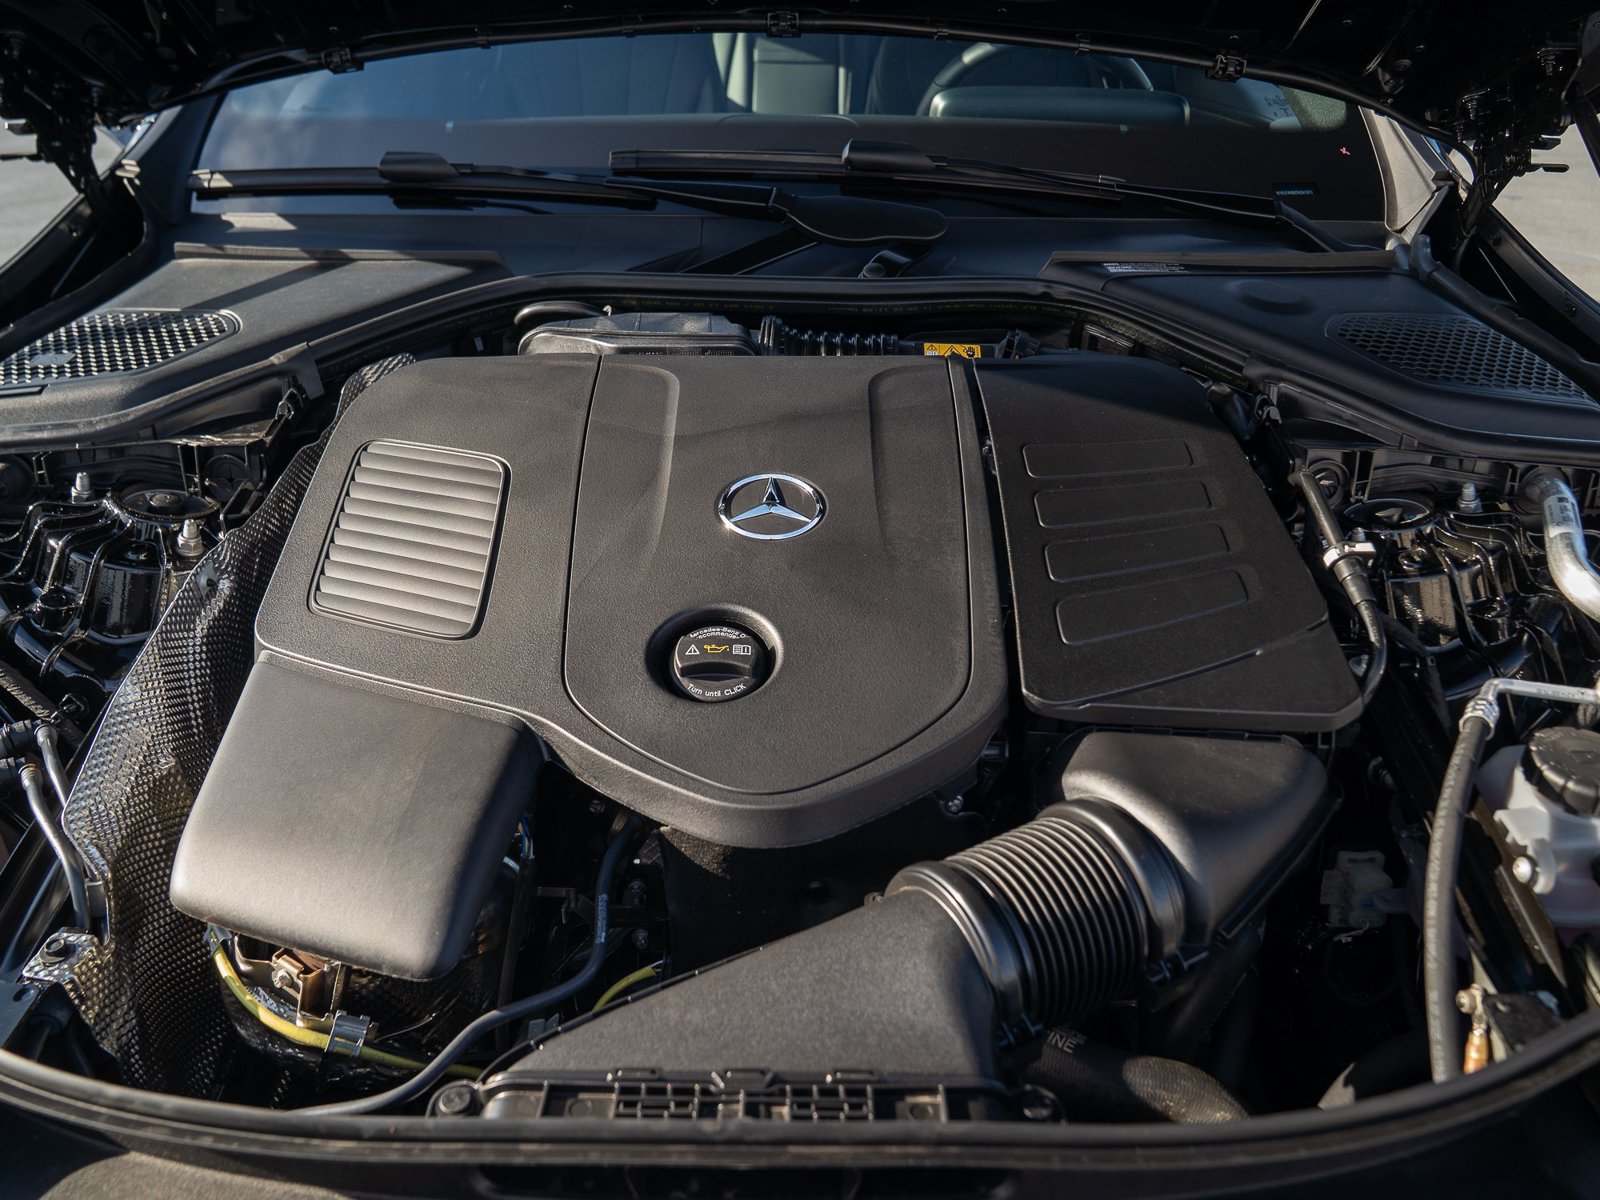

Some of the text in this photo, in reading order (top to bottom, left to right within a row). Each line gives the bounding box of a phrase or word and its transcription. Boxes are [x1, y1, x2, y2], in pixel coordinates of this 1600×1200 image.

[687, 683, 746, 697] Turn until CLICK
